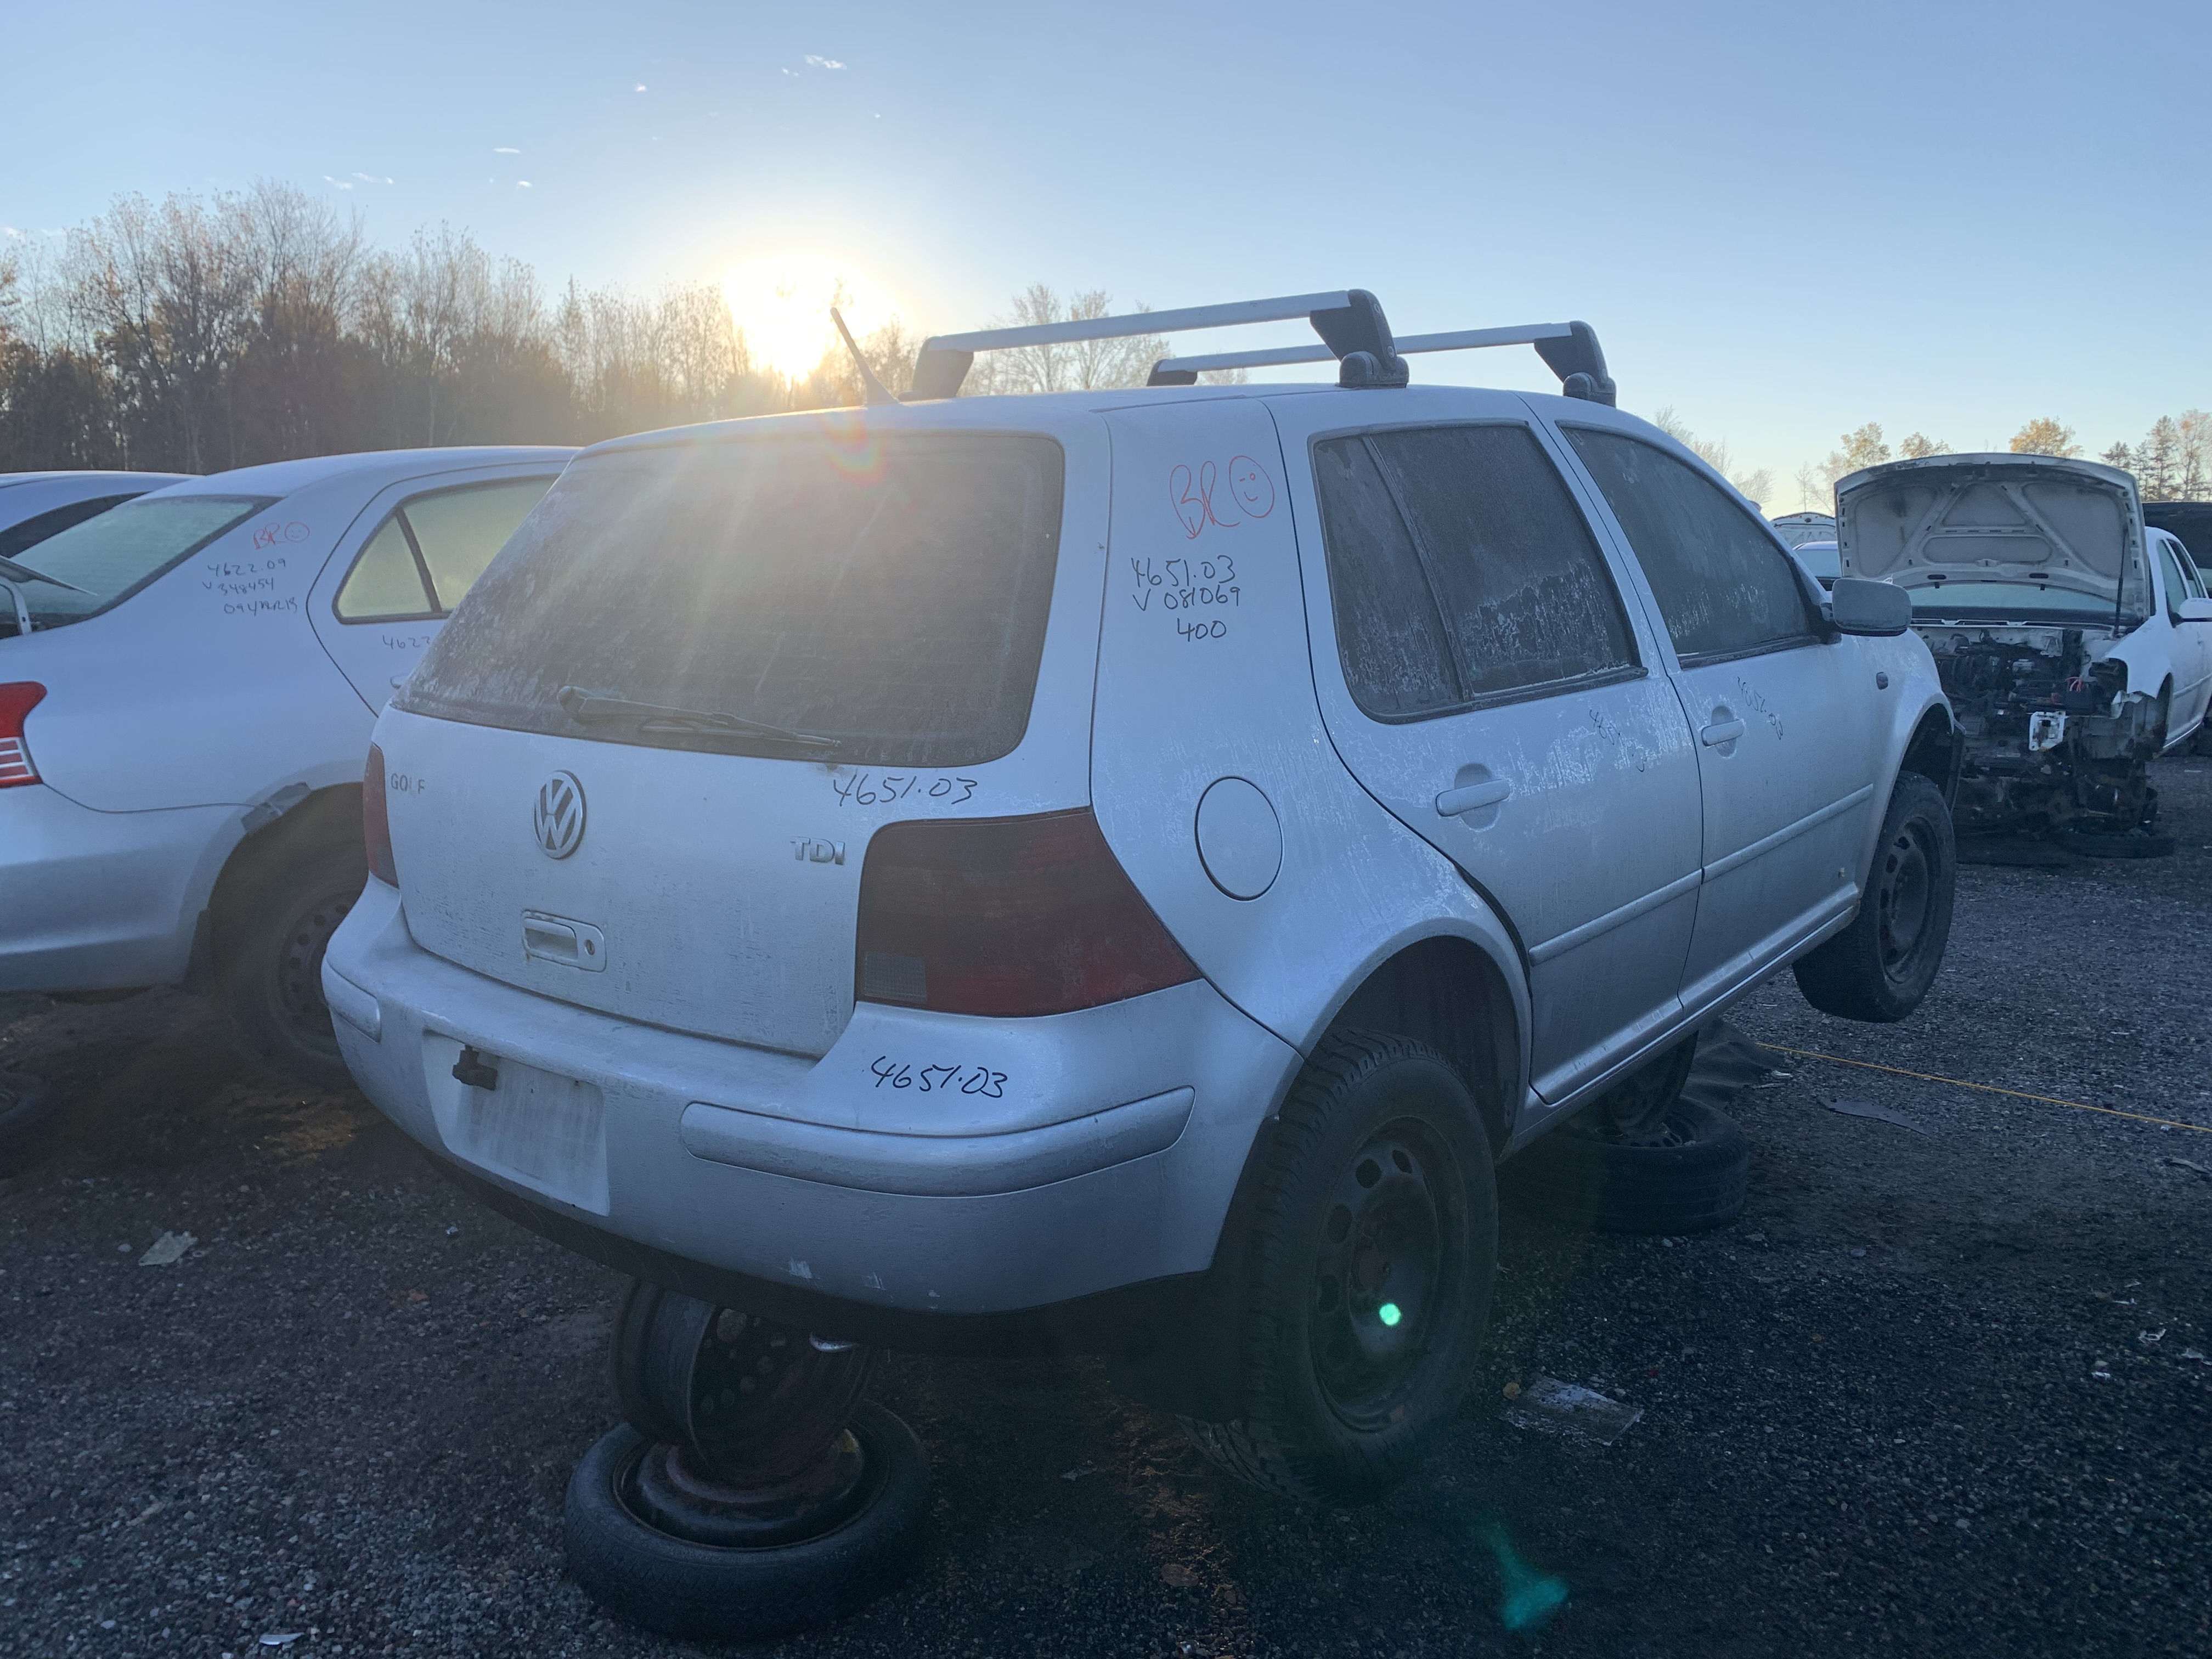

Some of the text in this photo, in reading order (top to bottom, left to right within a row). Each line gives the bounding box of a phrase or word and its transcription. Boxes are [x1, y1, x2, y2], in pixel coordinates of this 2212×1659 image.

[207, 557, 286, 577] 4622.09
[1131, 555, 1236, 588] 4651.03
[217, 577, 274, 596] 348454
[1132, 584, 1241, 612] V 081069
[1176, 617, 1227, 642] 400
[833, 773, 978, 807] 4651.03
[789, 836, 846, 866] TDI
[870, 1055, 1008, 1098] 4651.03
